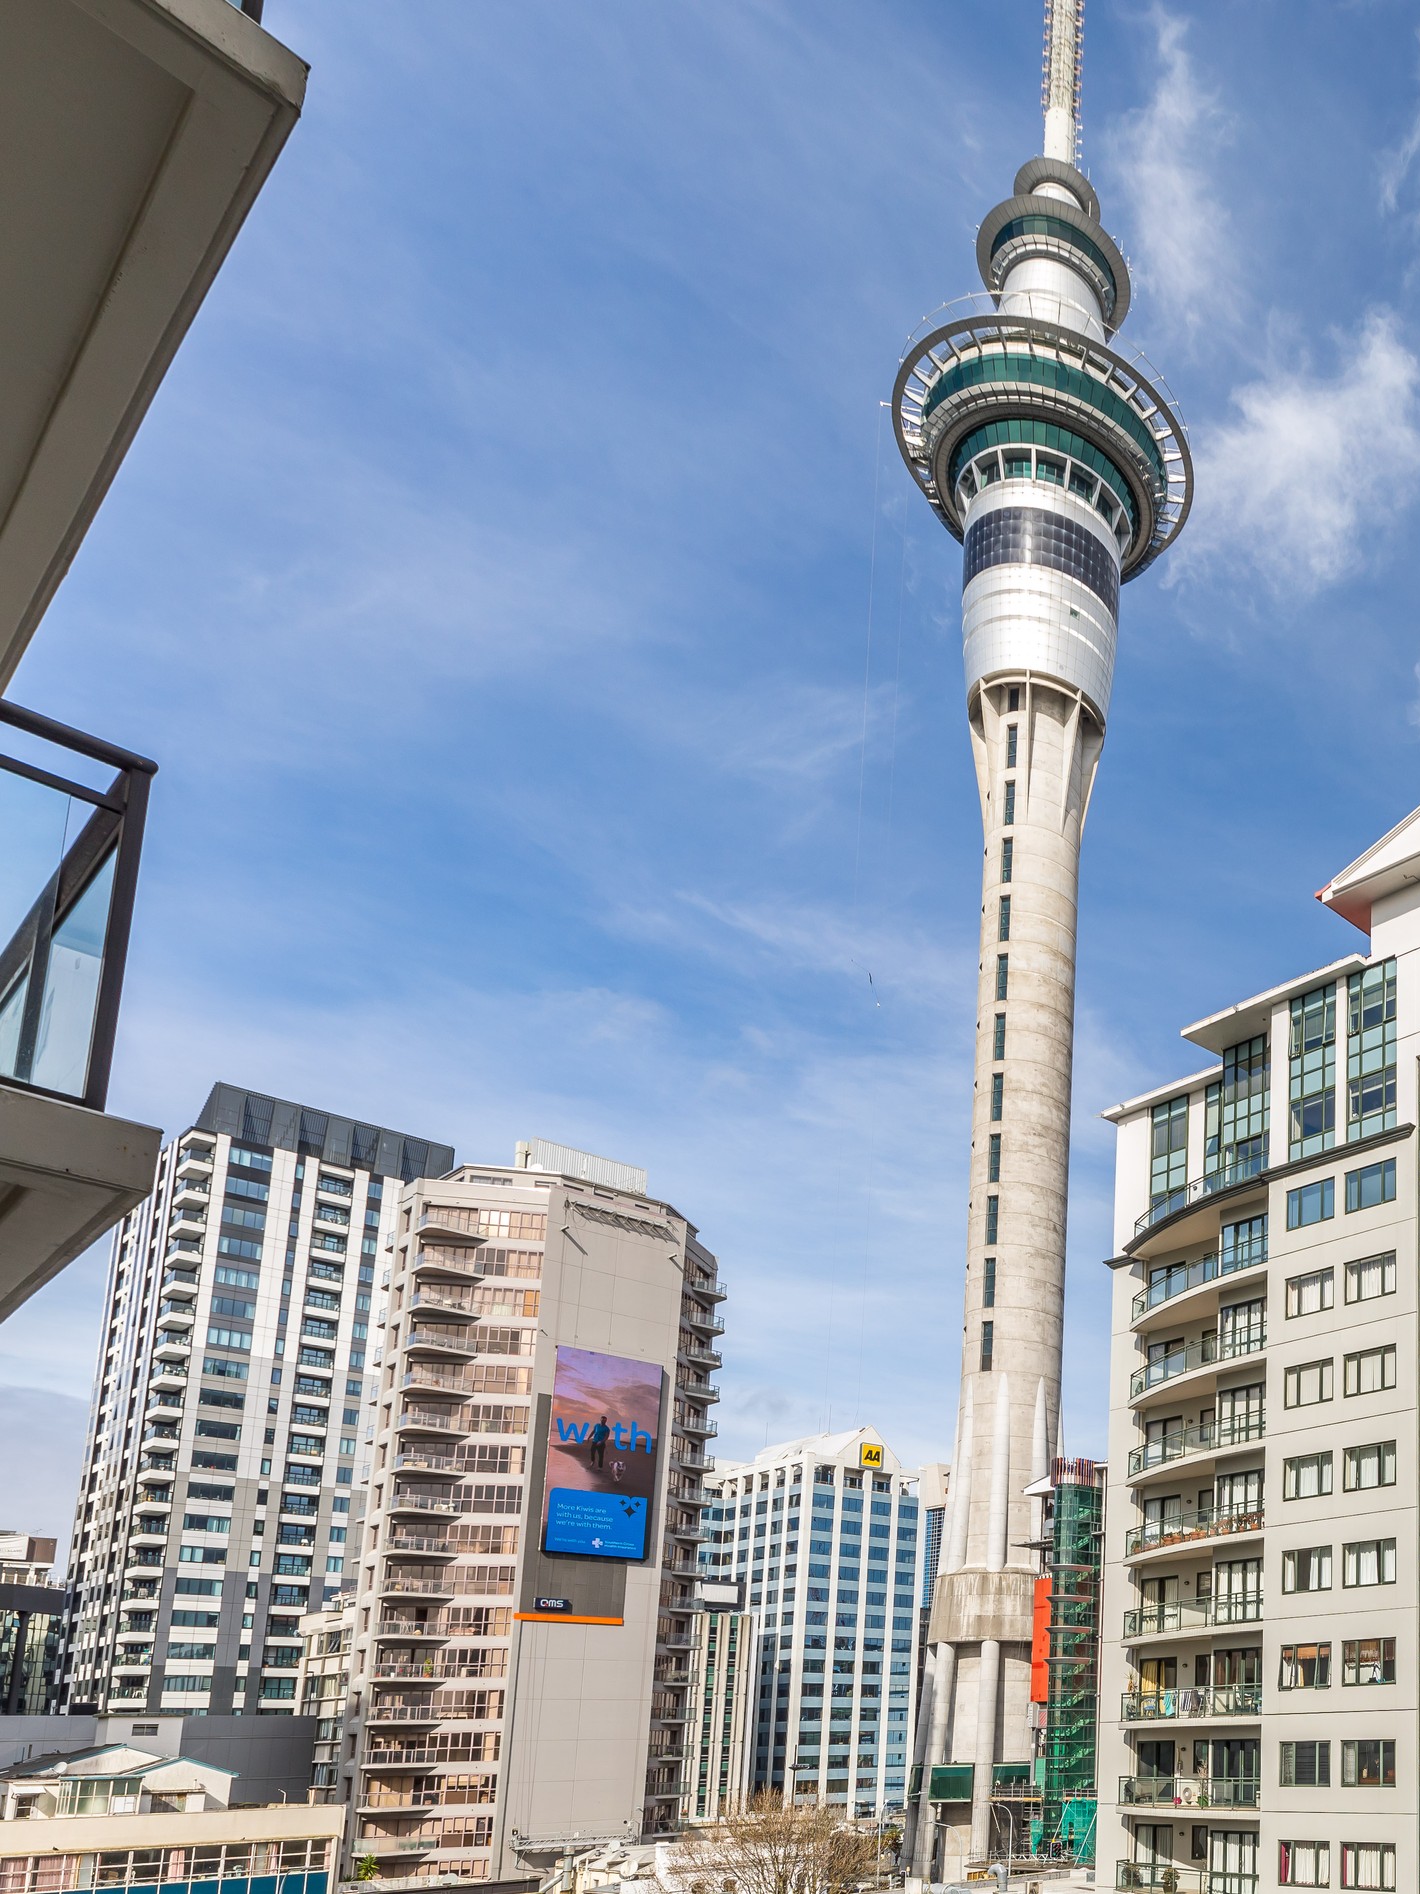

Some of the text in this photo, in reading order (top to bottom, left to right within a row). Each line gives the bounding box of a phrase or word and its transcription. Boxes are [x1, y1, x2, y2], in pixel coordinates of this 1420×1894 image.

[556, 1417, 653, 1454] wth
[864, 1450, 880, 1462] AA
[576, 1505, 594, 1513] Kiwis
[584, 1514, 614, 1523] because
[540, 1599, 564, 1608] QMS
